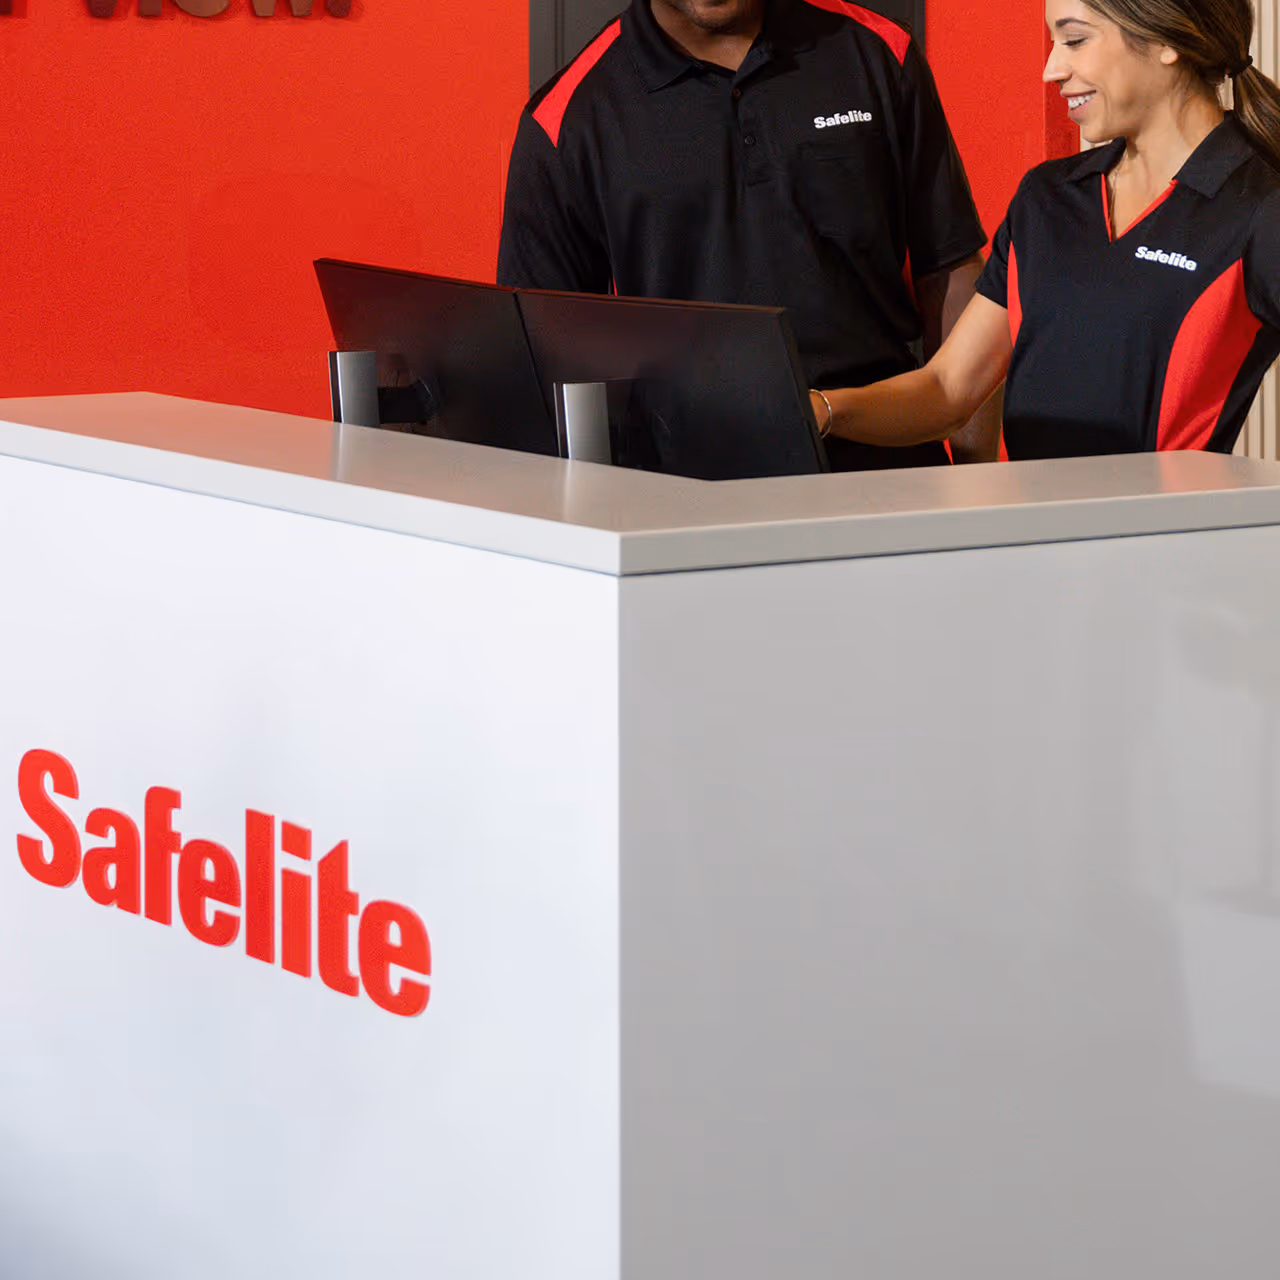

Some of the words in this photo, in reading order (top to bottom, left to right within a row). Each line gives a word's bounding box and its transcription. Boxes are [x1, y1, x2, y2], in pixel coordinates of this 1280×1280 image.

[813, 110, 872, 129] Safelite
[1134, 245, 1198, 271] Safelite
[16, 748, 432, 1018] Safelite
